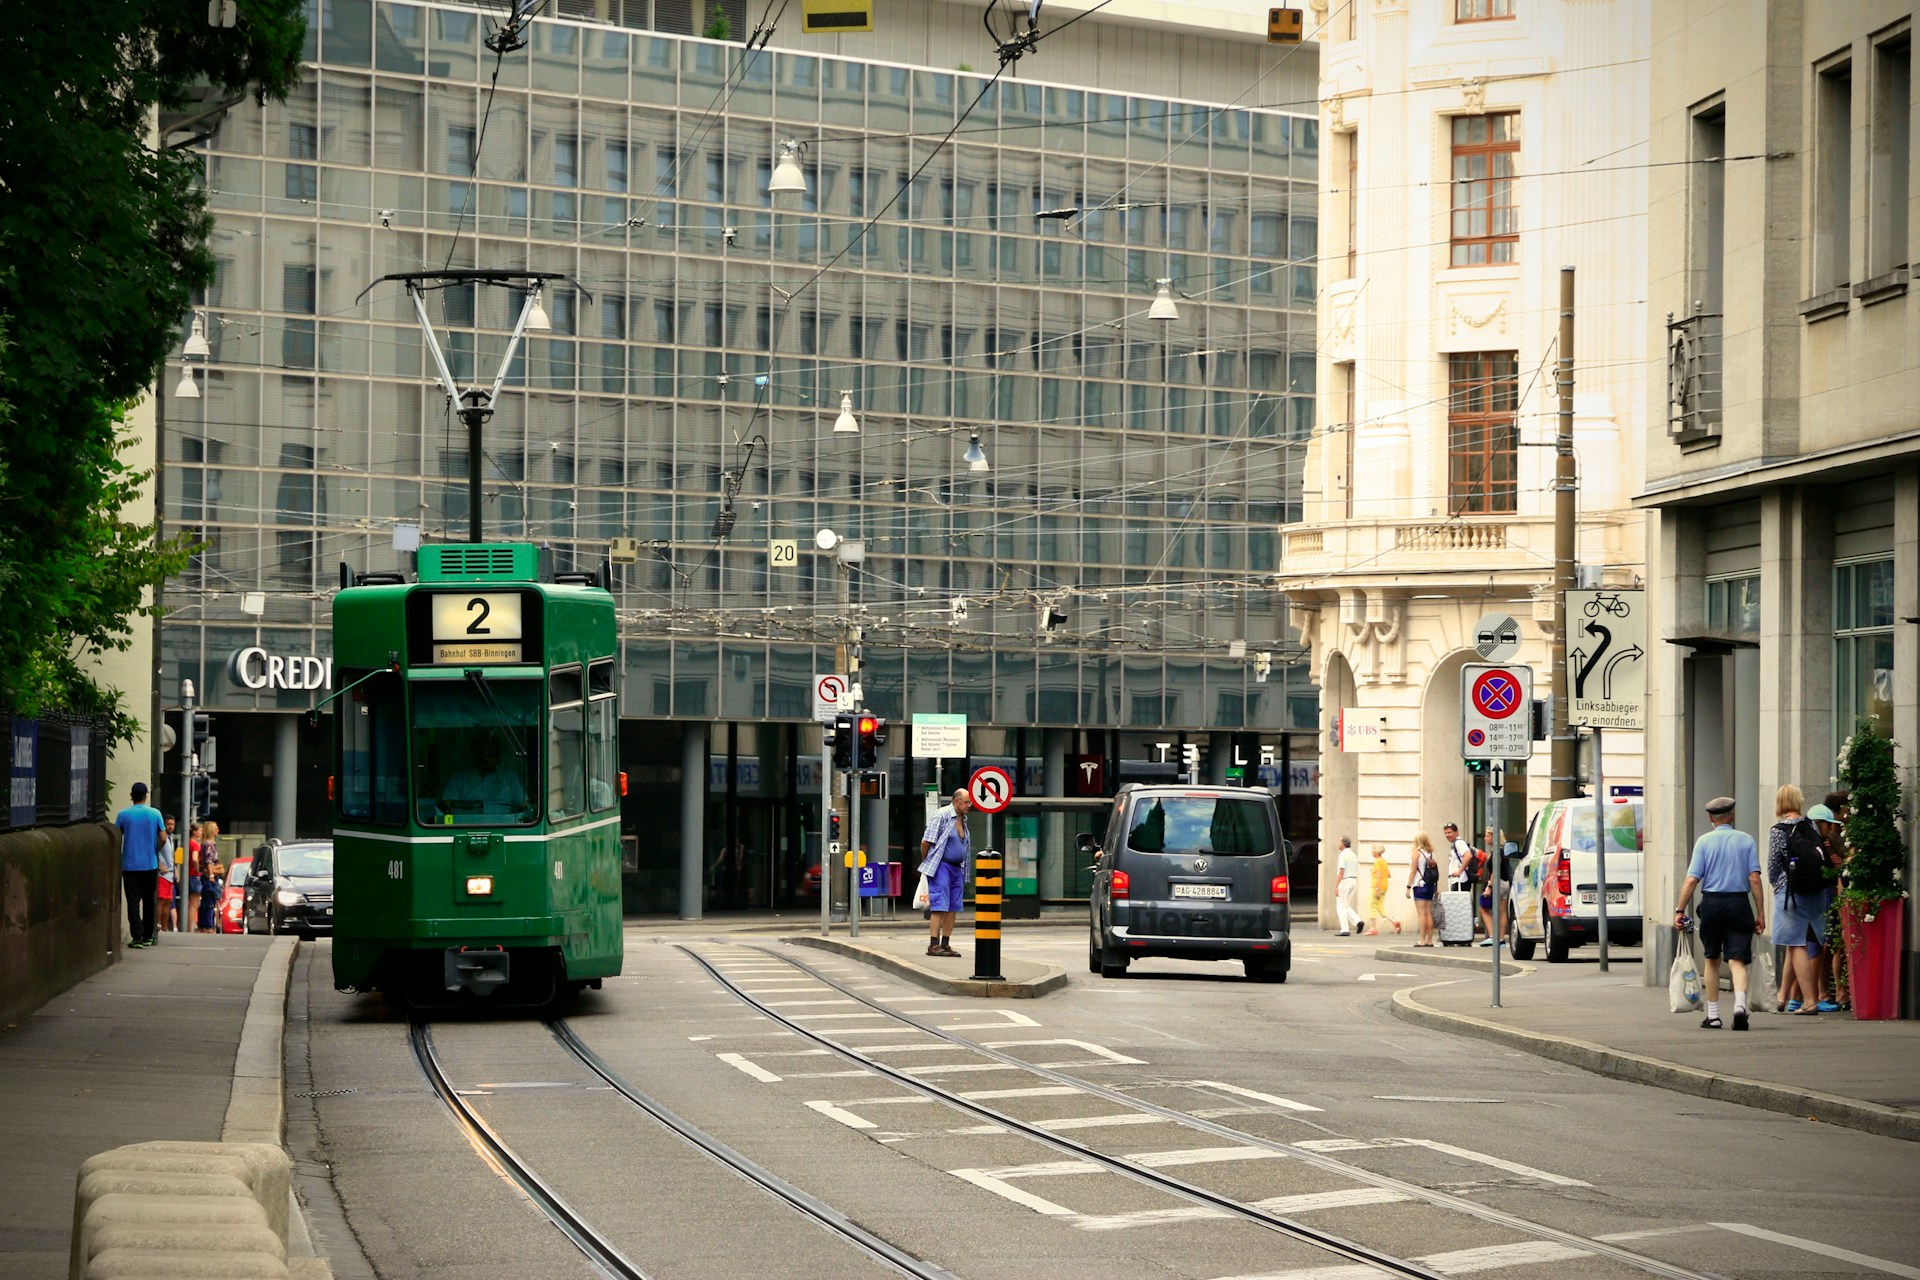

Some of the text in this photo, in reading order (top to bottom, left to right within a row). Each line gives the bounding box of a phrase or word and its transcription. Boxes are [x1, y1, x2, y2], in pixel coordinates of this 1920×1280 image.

[774, 545, 794, 561] 20
[466, 597, 491, 635] 2
[440, 649, 466, 658] Bahnhof
[1576, 700, 1639, 715] Linksabbieger
[1592, 715, 1636, 727] einordnen
[1358, 725, 1378, 735] UBS
[388, 860, 404, 880] 481
